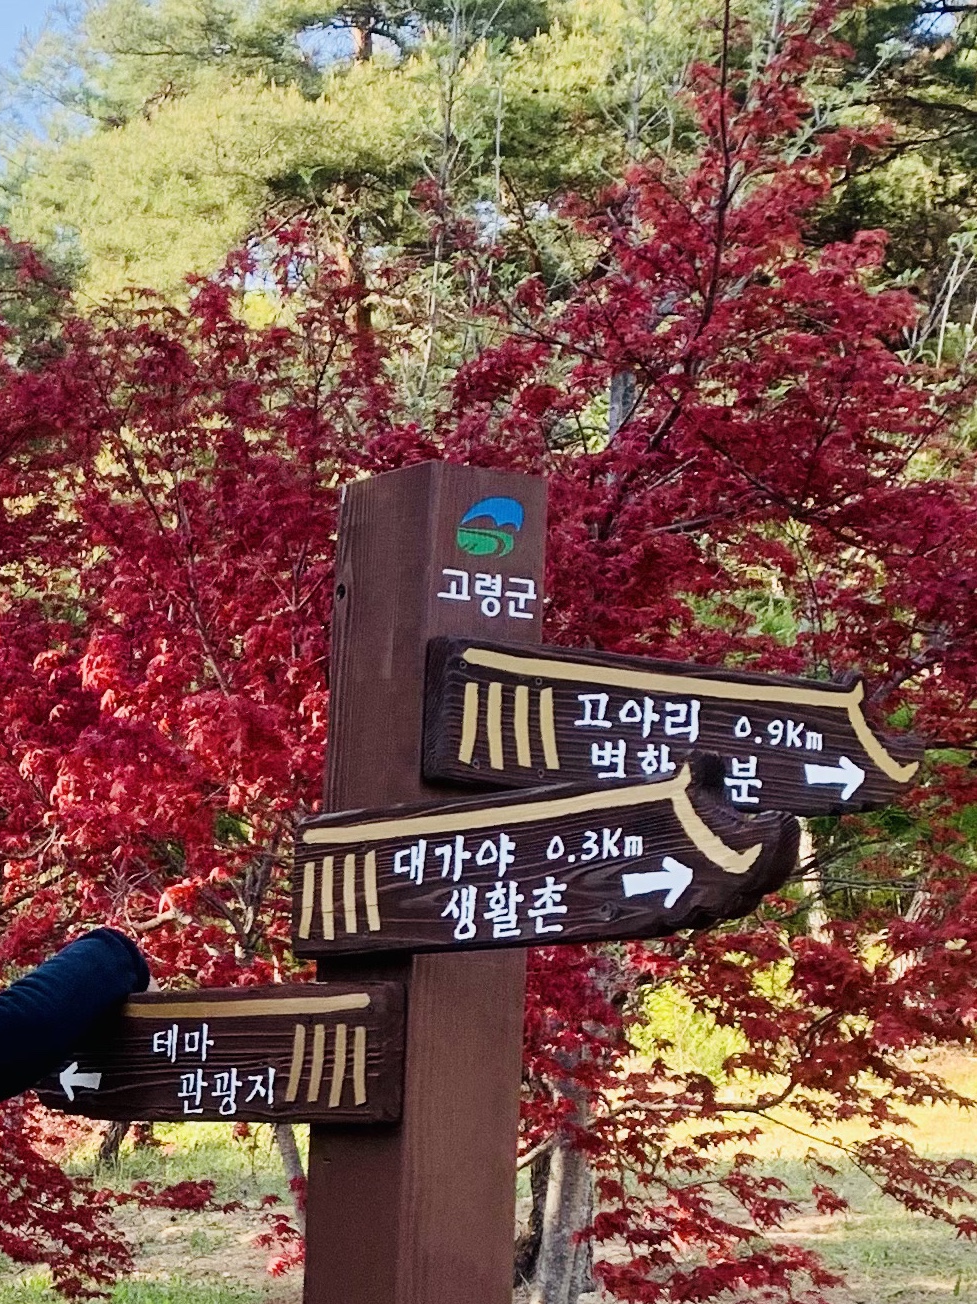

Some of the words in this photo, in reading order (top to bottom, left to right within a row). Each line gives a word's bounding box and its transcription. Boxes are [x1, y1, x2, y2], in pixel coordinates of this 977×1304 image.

[436, 568, 537, 620] 고령군
[574, 692, 701, 743] 고아리
[734, 715, 823, 751] 0.9Km
[393, 832, 517, 885] 대가야
[546, 827, 644, 863] 0.3Km
[440, 876, 568, 940] 생활촌
[152, 1022, 215, 1064] 테마
[177, 1067, 276, 1116] 관광지
